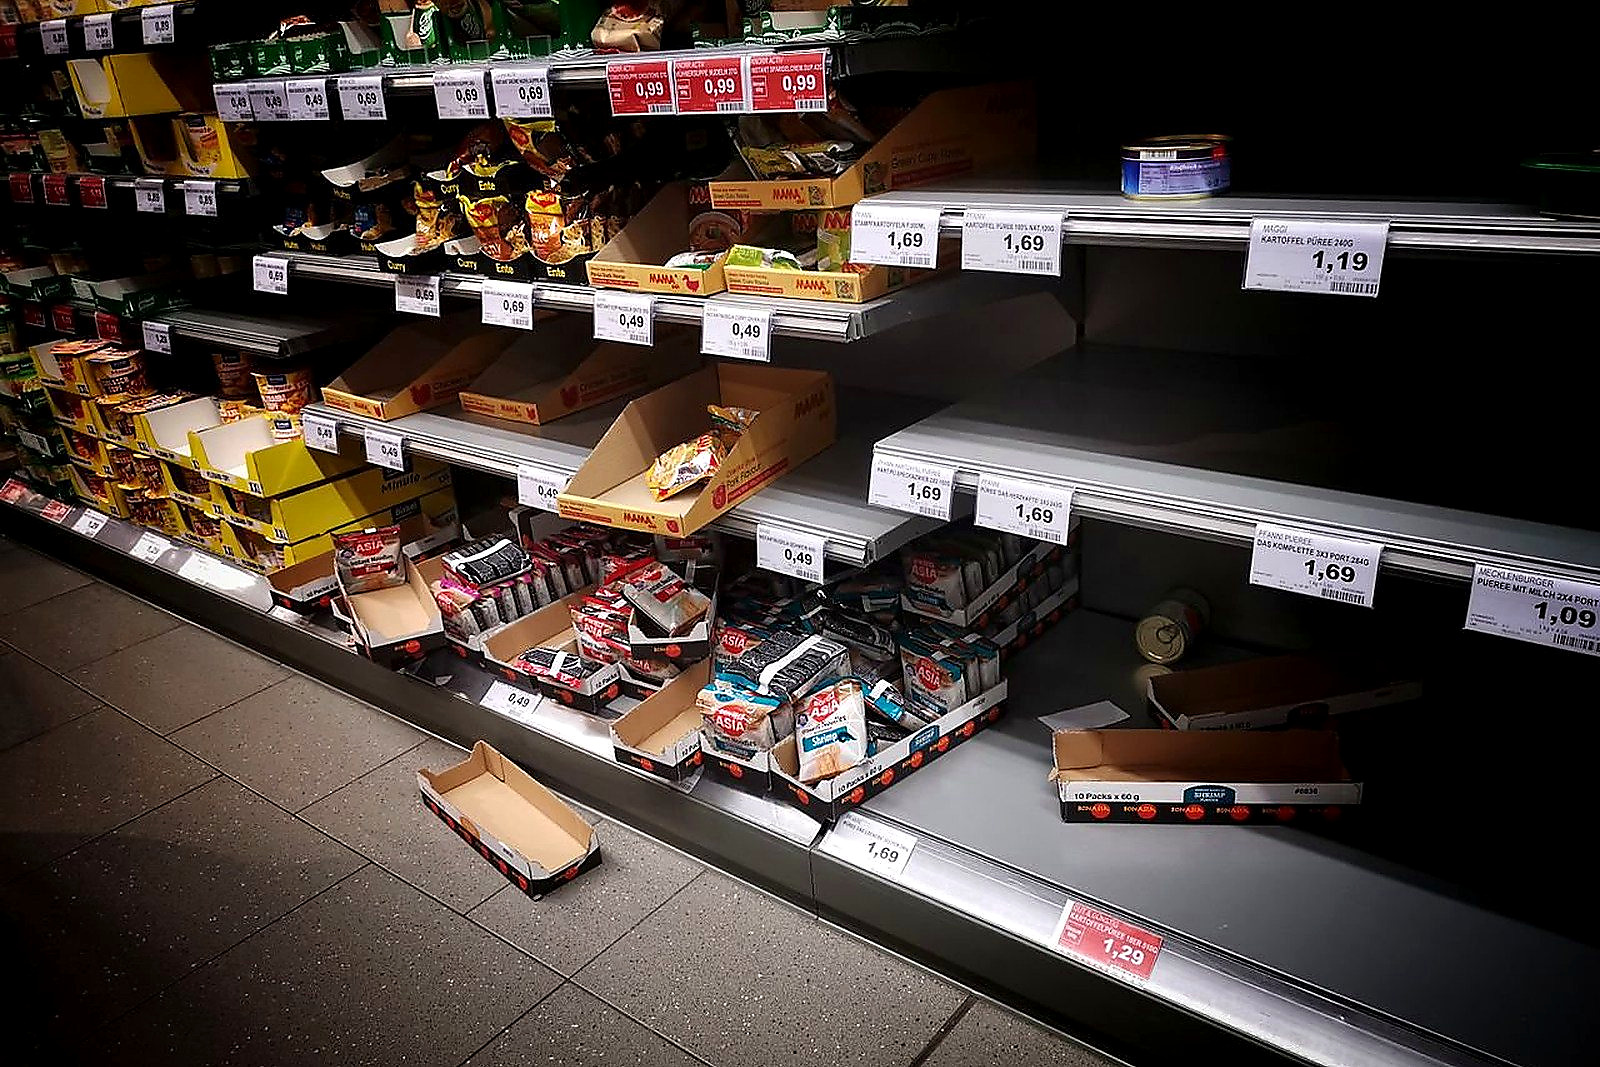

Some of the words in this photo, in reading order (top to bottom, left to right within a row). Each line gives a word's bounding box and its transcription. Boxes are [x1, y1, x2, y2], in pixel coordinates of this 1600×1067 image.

[635, 81, 664, 99] 0,99
[704, 77, 735, 97] 0,99
[782, 74, 816, 94] 0,99
[305, 94, 323, 108] 0,49
[357, 92, 377, 106] 0,69
[456, 88, 478, 104] 0,69
[519, 86, 543, 102] 0,69
[479, 181, 496, 191] Ente
[1262, 224, 1288, 234] MAGGI
[887, 231, 923, 250] 1,69
[1003, 233, 1044, 254] 1,69
[1261, 235, 1305, 245] KARTOFFEL
[1306, 235, 1333, 247] PÜREE
[457, 257, 477, 271] Curry
[495, 263, 514, 275] Ente
[1312, 250, 1369, 274] 1,19
[546, 266, 566, 278] Ente
[649, 273, 675, 284] MAMA
[415, 288, 434, 302] 0,69
[503, 299, 524, 314] 0,69
[620, 314, 643, 329] 0,49
[732, 323, 760, 339] 0,49
[907, 482, 941, 500] 1,69
[1016, 503, 1053, 523] 1,69
[357, 540, 384, 552] ASIA
[1256, 538, 1271, 549] DAS
[1272, 542, 1314, 556] KOMPLETTE
[784, 548, 812, 565] 0,49
[1305, 559, 1356, 583] 1,69
[1479, 567, 1554, 588] MECKLENBURGER
[1477, 578, 1511, 591] PUEREE
[1528, 587, 1556, 600] MILCH
[1534, 601, 1596, 629] 1,09
[722, 634, 746, 648] ASIA
[918, 666, 940, 687] ASIA
[507, 692, 530, 708] 0,49
[811, 700, 840, 717] ASIA
[716, 715, 745, 731] ASIA
[868, 842, 898, 863] 1,69
[1103, 938, 1145, 966] 1,29
